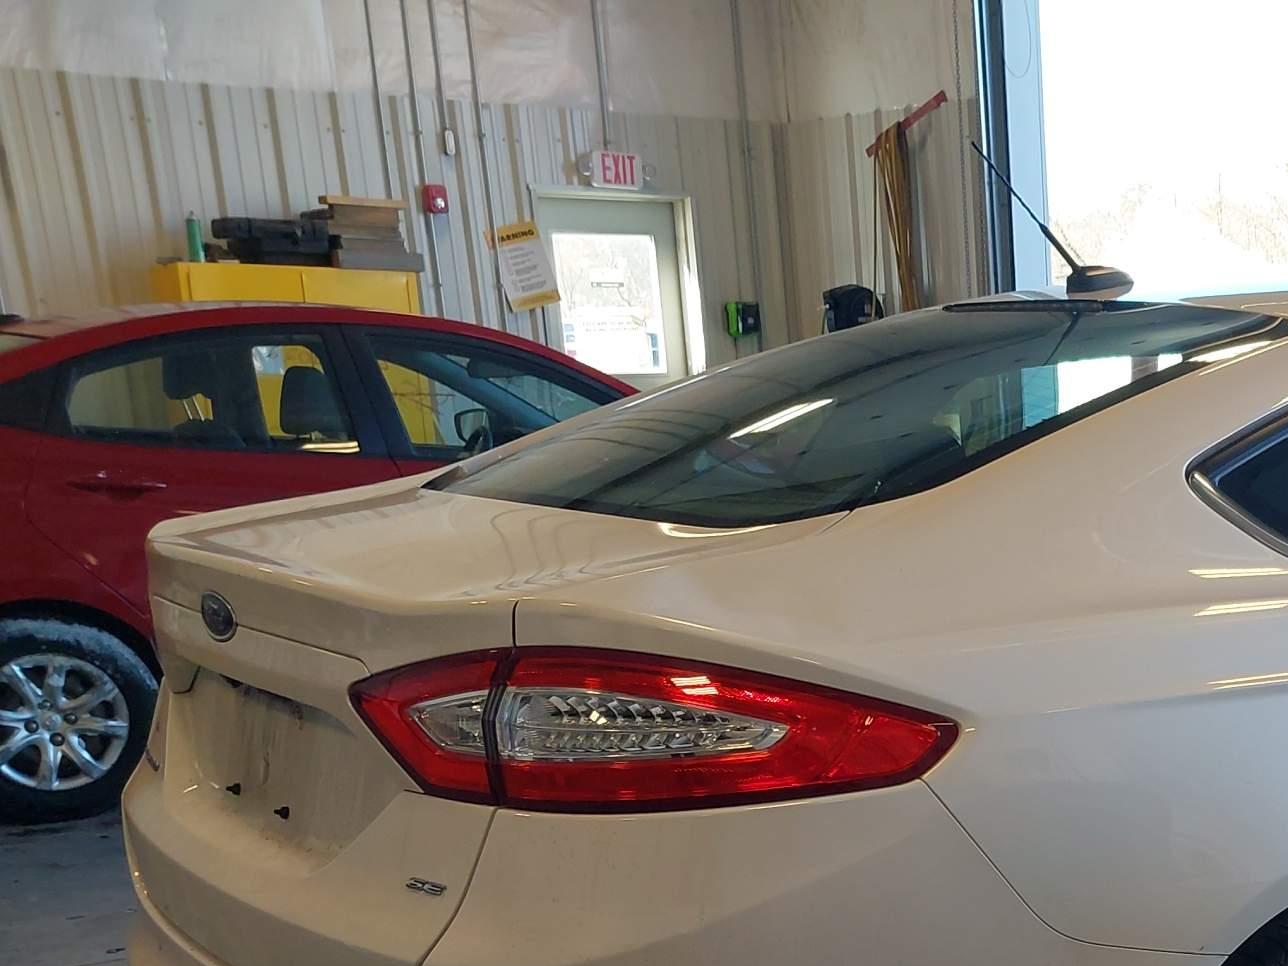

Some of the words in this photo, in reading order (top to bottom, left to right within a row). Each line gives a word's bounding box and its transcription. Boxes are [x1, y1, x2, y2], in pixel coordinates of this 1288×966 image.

[601, 153, 636, 185] EXIT
[497, 229, 535, 242] ARNING
[405, 877, 447, 896] SE
